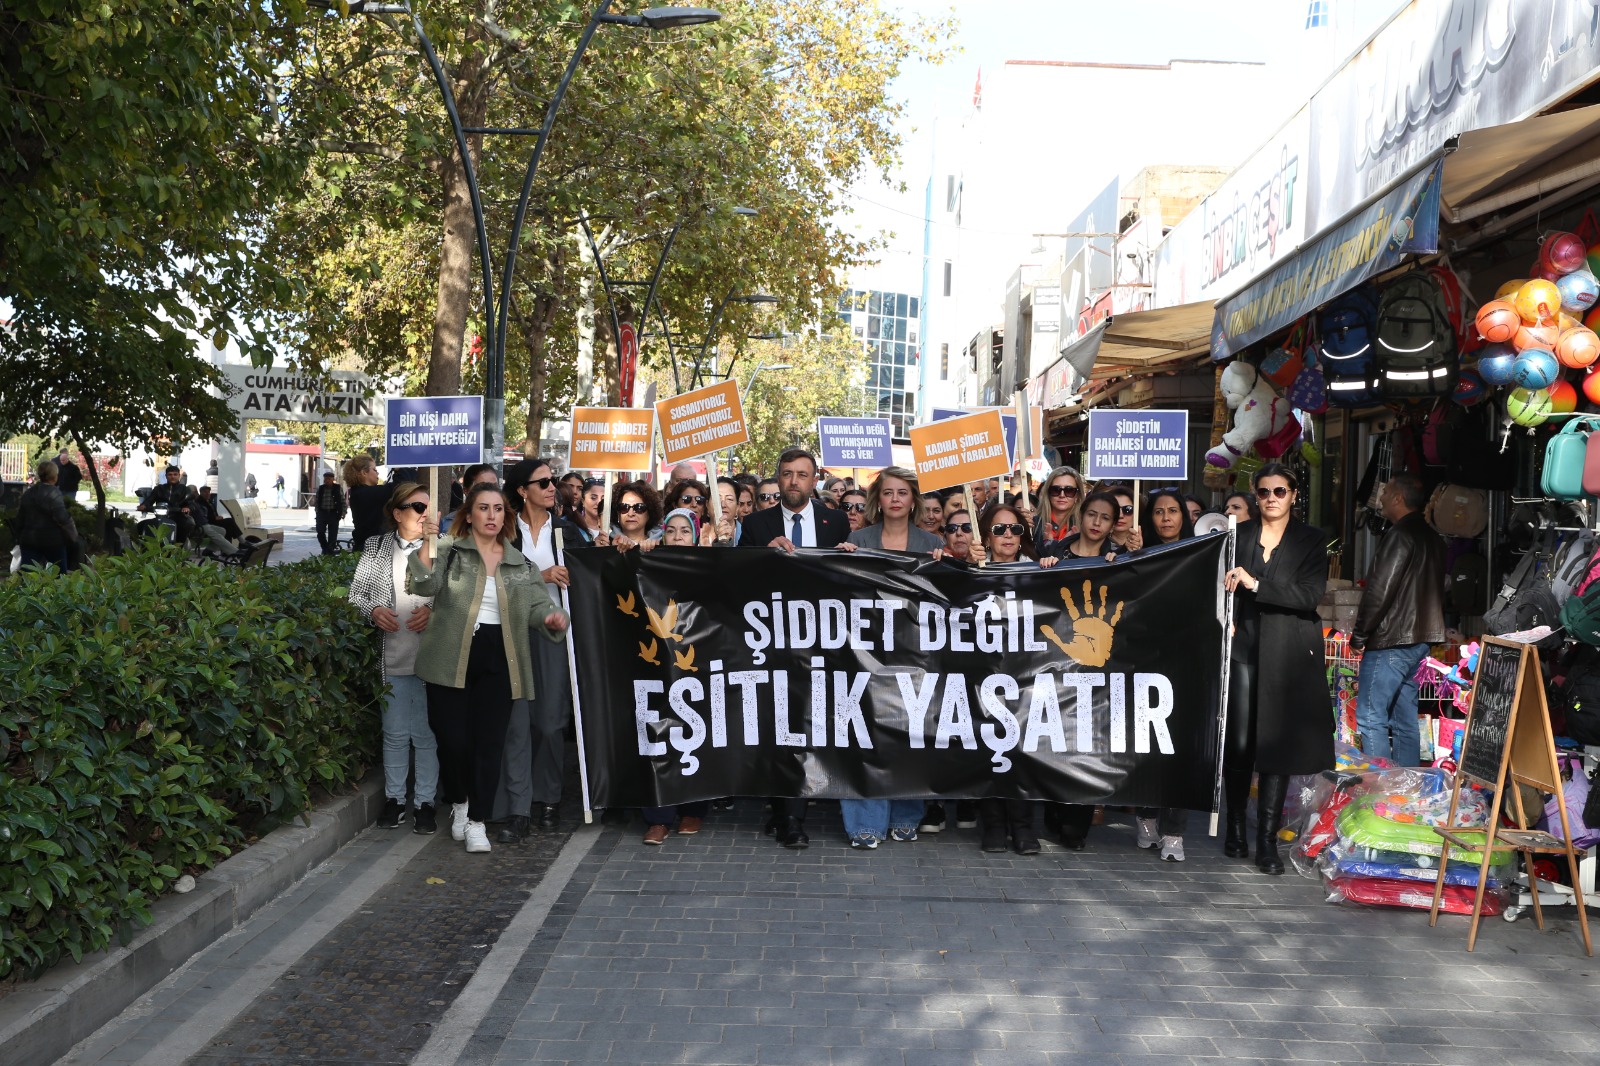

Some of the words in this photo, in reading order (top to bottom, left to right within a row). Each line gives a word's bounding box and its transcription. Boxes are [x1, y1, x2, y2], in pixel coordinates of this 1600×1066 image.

[670, 393, 726, 420] SUSMUYORUZ
[400, 412, 416, 427] BİR
[419, 411, 438, 430] KİŞİ
[441, 412, 469, 426] DAHA
[577, 422, 610, 435] KADINA
[612, 420, 647, 438] ŞİDDETE
[670, 407, 732, 436] KORKMUYORUZ
[823, 423, 865, 436] KARANLIĞA
[866, 423, 886, 436] DEĞİL
[1116, 418, 1160, 437] ŞİDDETİN
[390, 429, 477, 446] EKSİLMEYECEĞİZ!
[667, 434, 690, 453] İTAAT
[691, 420, 742, 446] ETMİYORUZ!
[830, 437, 883, 450] DAYANIŞMAYA
[925, 439, 958, 457] KADINA
[959, 431, 989, 452] ŞİDDET
[1095, 435, 1143, 450] BAHANESİ
[1146, 438, 1181, 451] OLMAZ
[575, 440, 597, 452] SIFIR
[600, 440, 646, 453] TOLERANS!
[841, 449, 856, 459] SES
[857, 449, 874, 460] VER!
[917, 456, 960, 474] TOPLUMU
[961, 444, 1003, 464] YARALAR!
[1096, 452, 1138, 467] FAİLLERİ
[1140, 454, 1179, 468] VARDIR!
[743, 591, 902, 665] ŞİDDET
[918, 590, 1047, 653] DEĞİL
[633, 655, 874, 775] EŞİTLİK
[895, 672, 1175, 773] YAŞATIR
